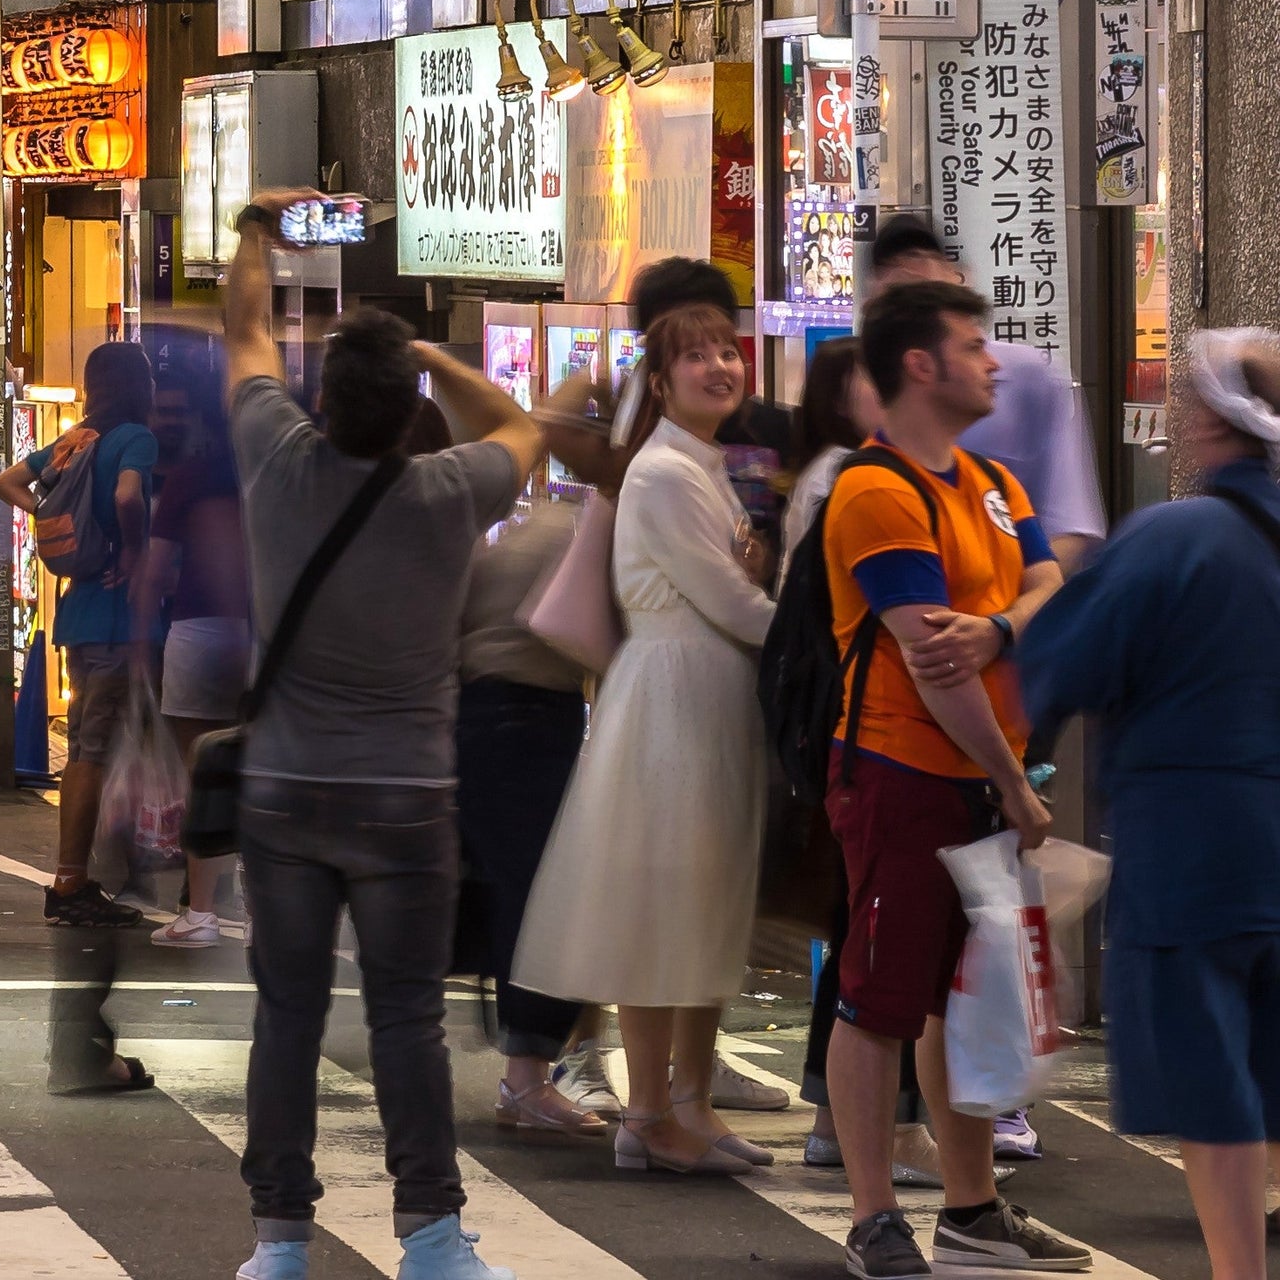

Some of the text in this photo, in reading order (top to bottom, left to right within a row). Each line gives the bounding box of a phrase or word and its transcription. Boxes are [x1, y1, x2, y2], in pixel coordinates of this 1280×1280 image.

[937, 62, 956, 152] Security
[960, 65, 985, 188] Your Safety
[940, 155, 961, 240] Camera
[984, 22, 1027, 344] 防犯カメラ作動中
[158, 245, 169, 277] 5F
